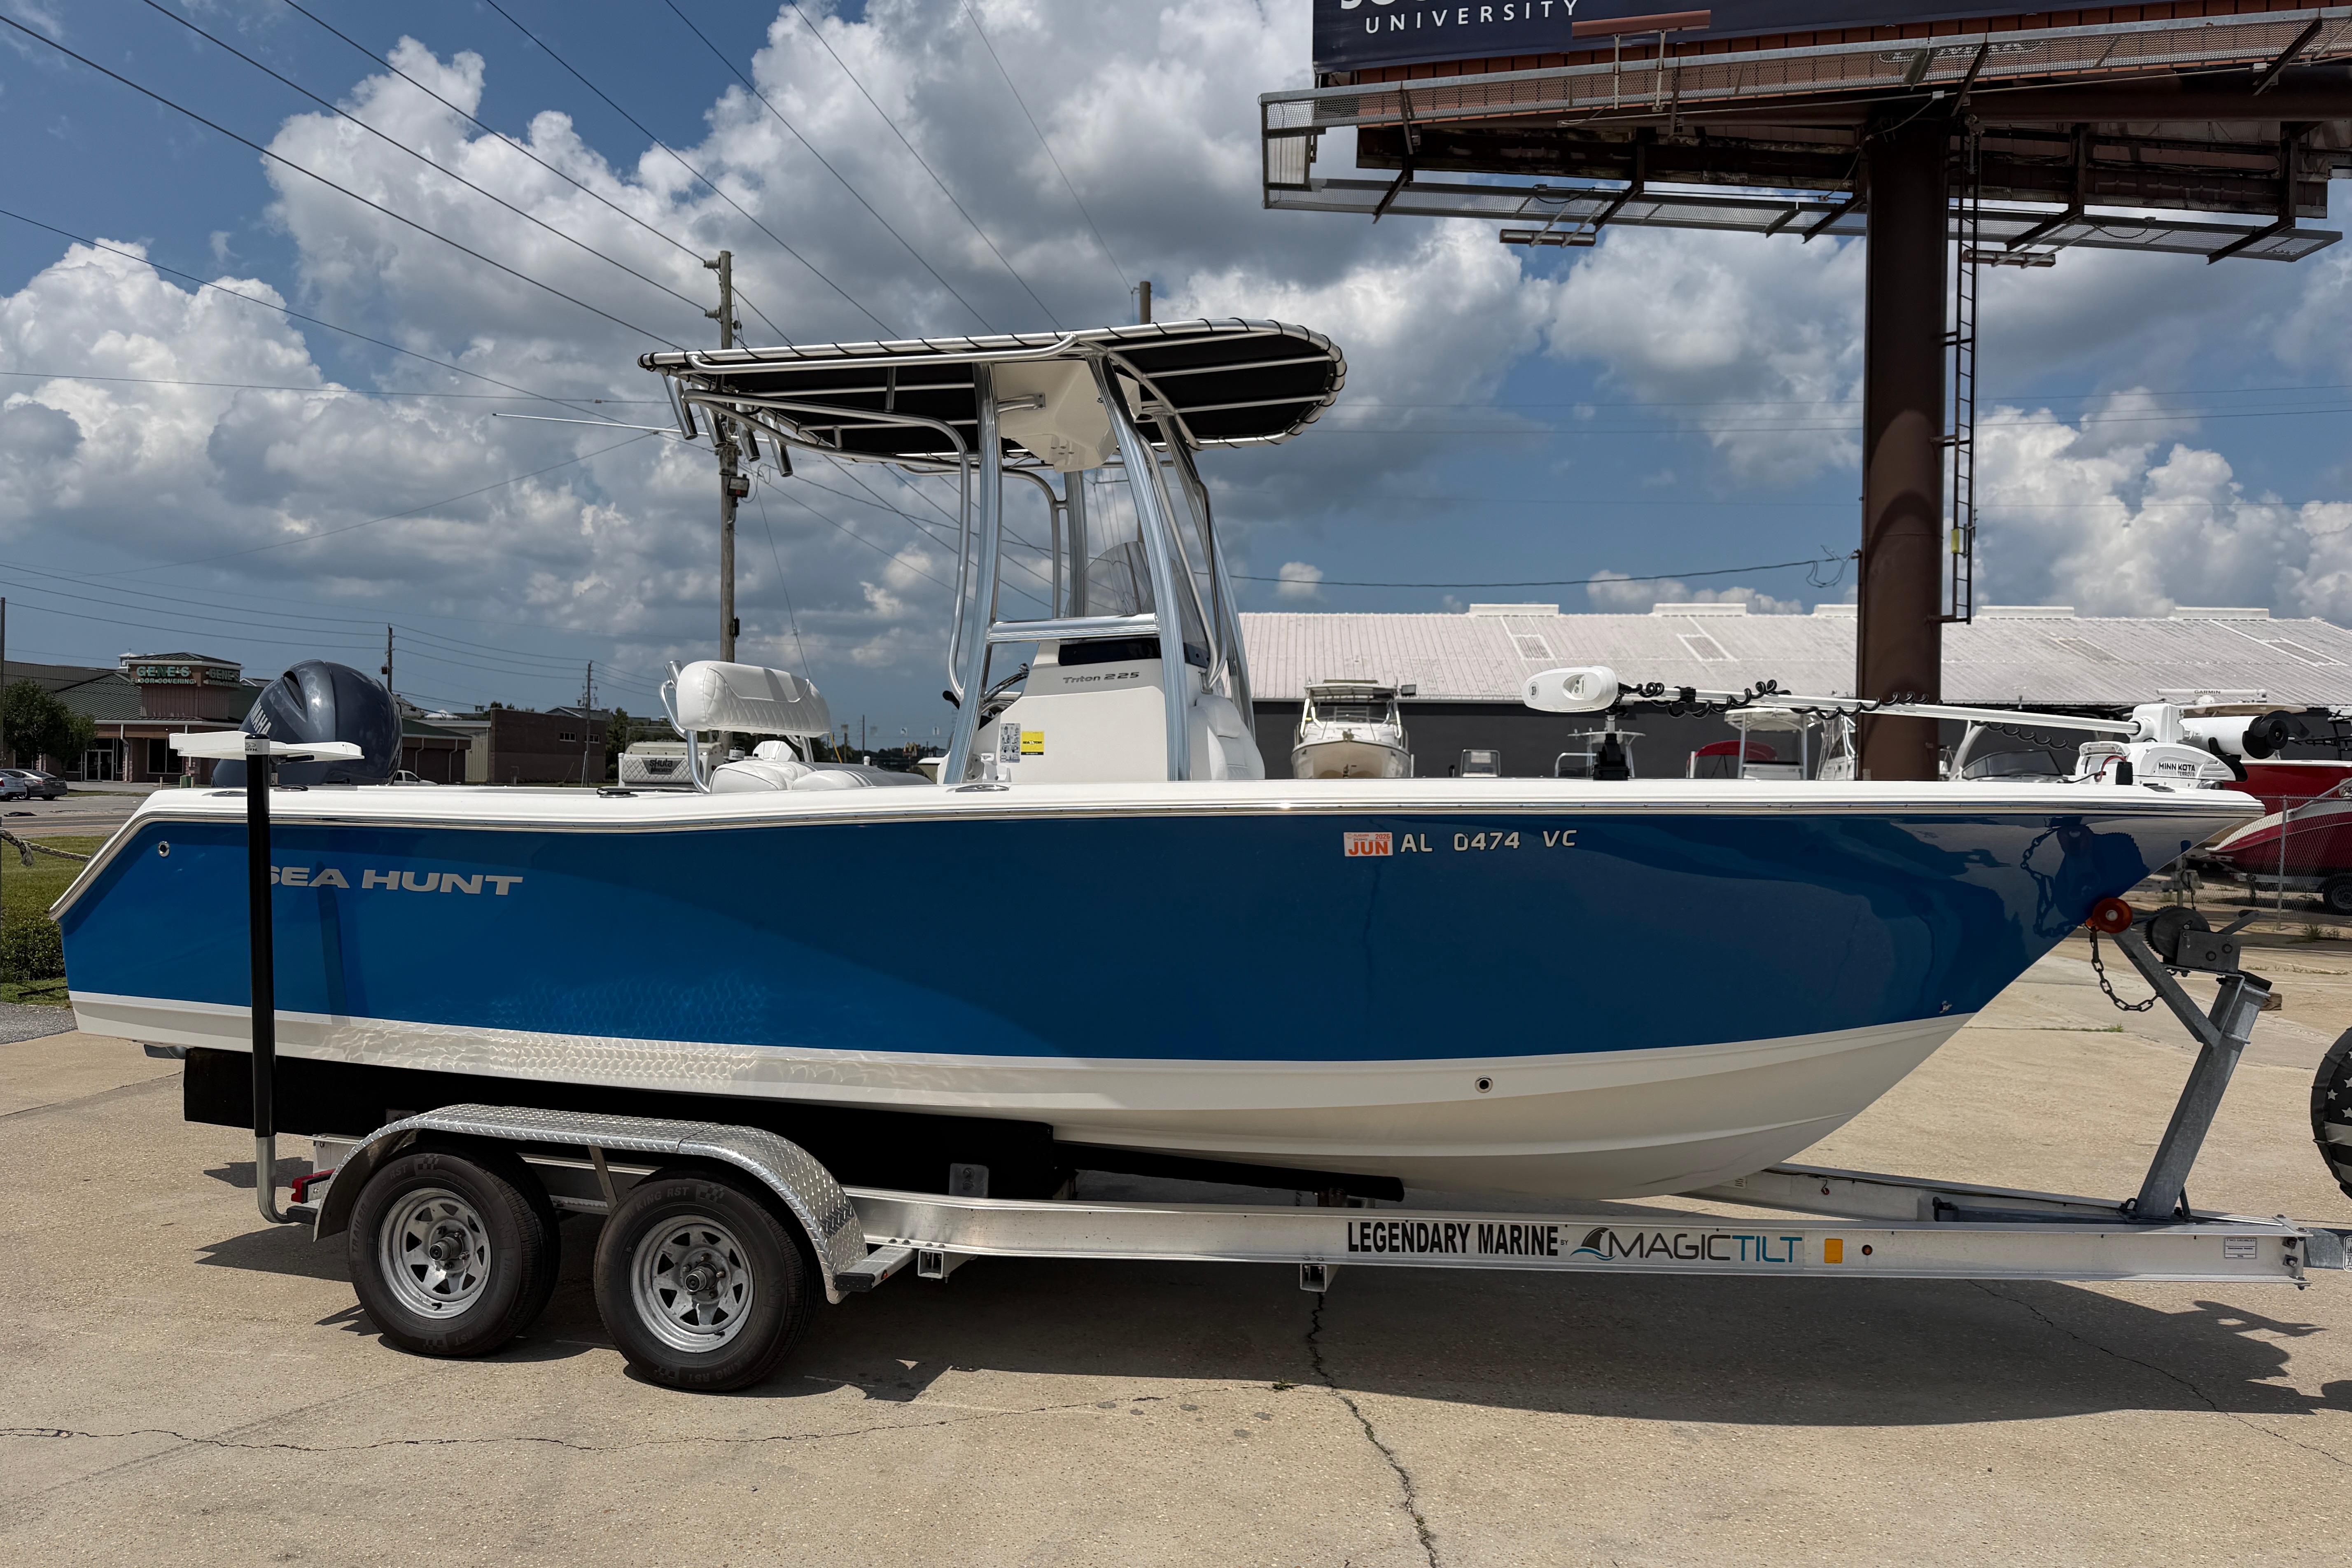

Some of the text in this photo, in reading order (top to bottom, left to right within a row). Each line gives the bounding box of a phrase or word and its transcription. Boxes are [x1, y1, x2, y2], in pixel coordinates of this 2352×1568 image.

[1365, 0, 1577, 33] UNIVERSITY
[136, 666, 191, 677] GENE'S
[1062, 672, 1140, 684] Triton 225
[2158, 762, 2196, 772] MINN KOTA
[1348, 841, 1389, 855] JUN
[1400, 830, 1577, 852] AL 0474 VC
[362, 869, 523, 896] HUNT
[636, 1186, 690, 1211] KING RST
[1347, 1221, 1471, 1253] LEGENDARY
[1477, 1223, 1559, 1256] MARINE
[1608, 1231, 1802, 1263] MAGICTILT
